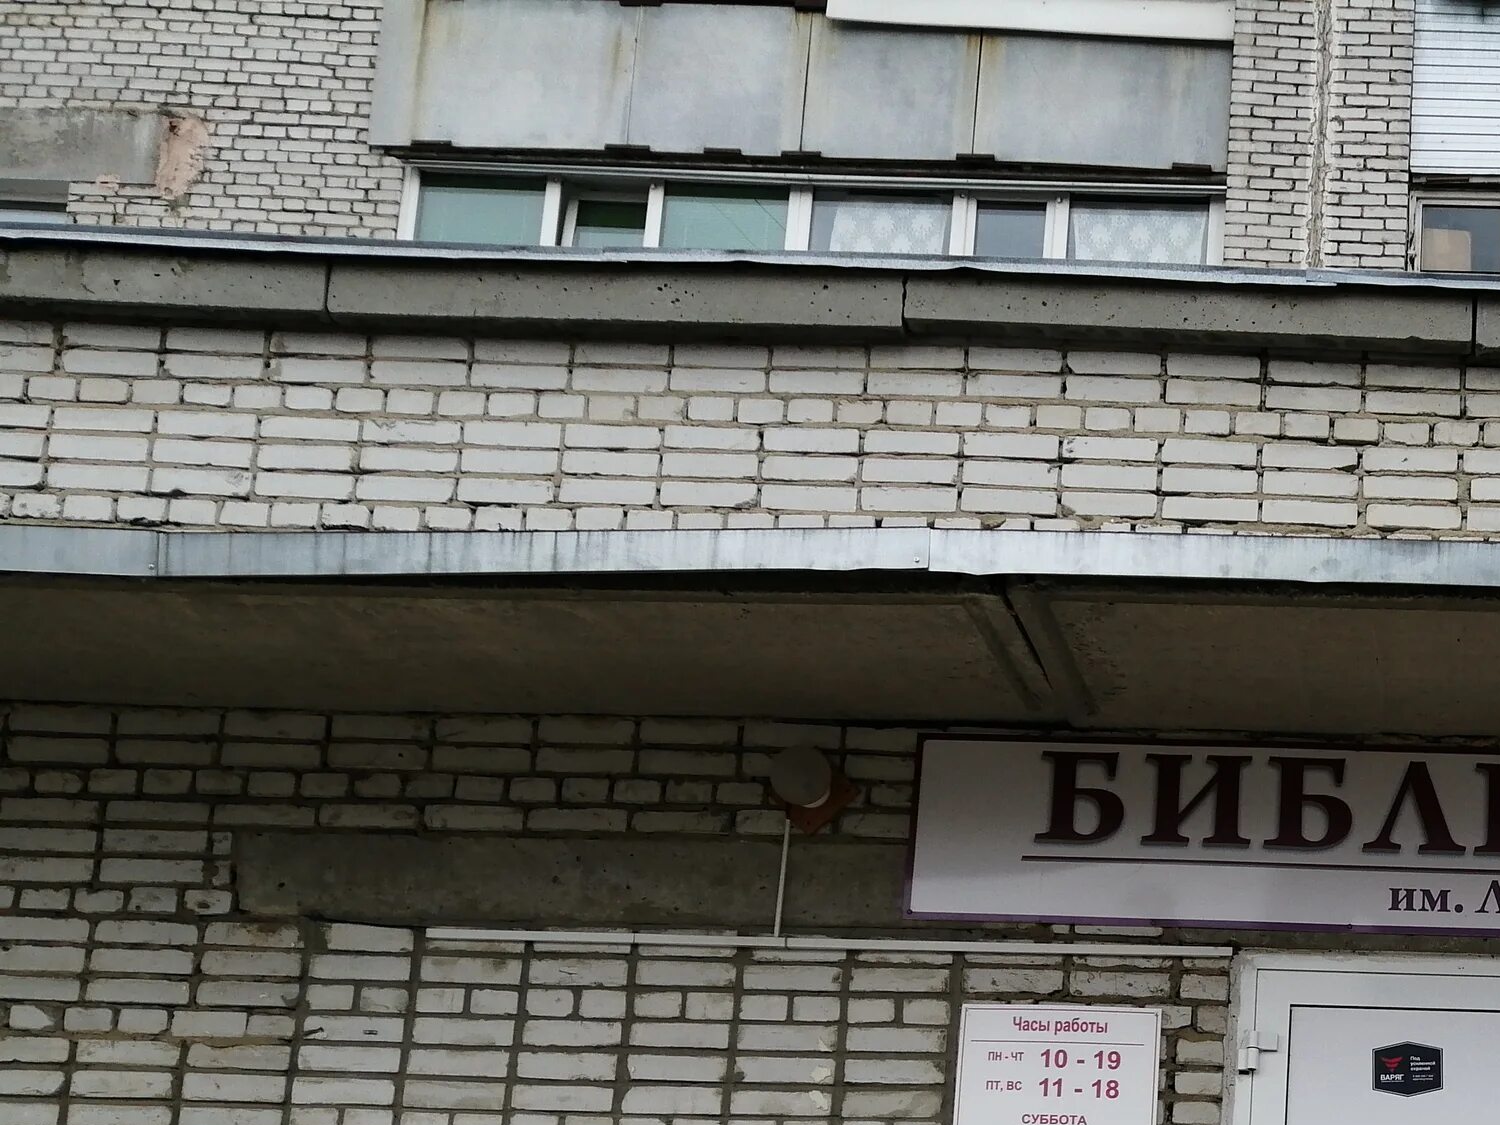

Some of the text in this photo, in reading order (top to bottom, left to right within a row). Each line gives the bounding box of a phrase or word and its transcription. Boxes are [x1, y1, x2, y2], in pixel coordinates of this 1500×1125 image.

[1388, 886, 1464, 914] им.
[1012, 1016, 1108, 1035] Часы работы
[988, 1051, 1003, 1061] ПН
[1011, 1051, 1024, 1062] ЧТ
[1040, 1048, 1068, 1069] 10
[1093, 1050, 1121, 1070] 19
[986, 1080, 1003, 1092] ПТ,
[1006, 1081, 1023, 1091] ВС
[1039, 1077, 1063, 1098] 11
[1091, 1079, 1120, 1099] 18
[1021, 1113, 1087, 1125] СУББОТА
